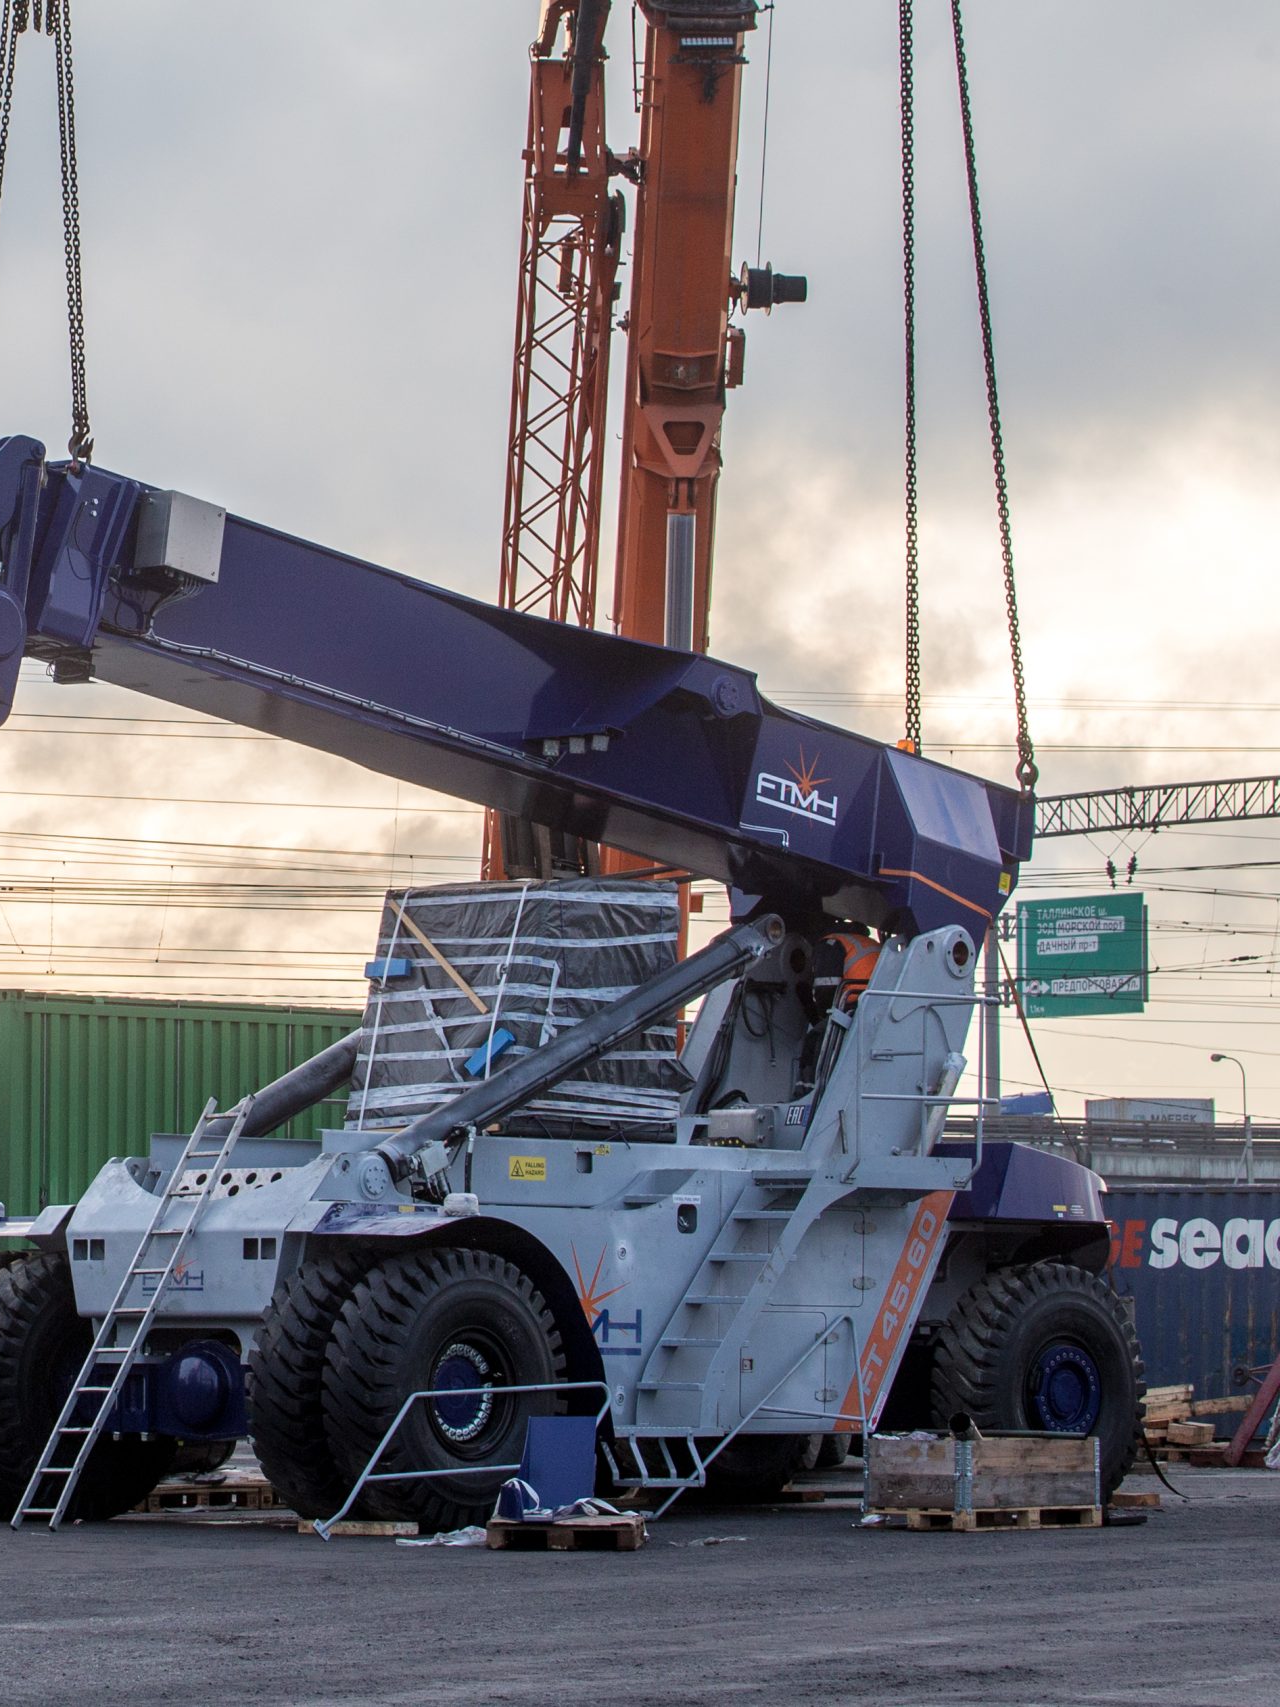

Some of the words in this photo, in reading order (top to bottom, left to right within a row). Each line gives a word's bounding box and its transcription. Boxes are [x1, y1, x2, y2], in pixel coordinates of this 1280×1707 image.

[756, 772, 839, 819] FTMH
[1036, 906, 1096, 920] ТАЛЛИНСКОЕ
[1057, 919, 1100, 932] МОРСКОЙ
[1102, 920, 1123, 931] порт
[1038, 938, 1077, 953] ДАЧНЫЙ
[1078, 942, 1097, 952] пр-т
[1150, 1114, 1197, 1122] MAERSK
[525, 1161, 545, 1169] FALLING
[862, 1343, 884, 1397] FT
[882, 1209, 937, 1340] 45-60
